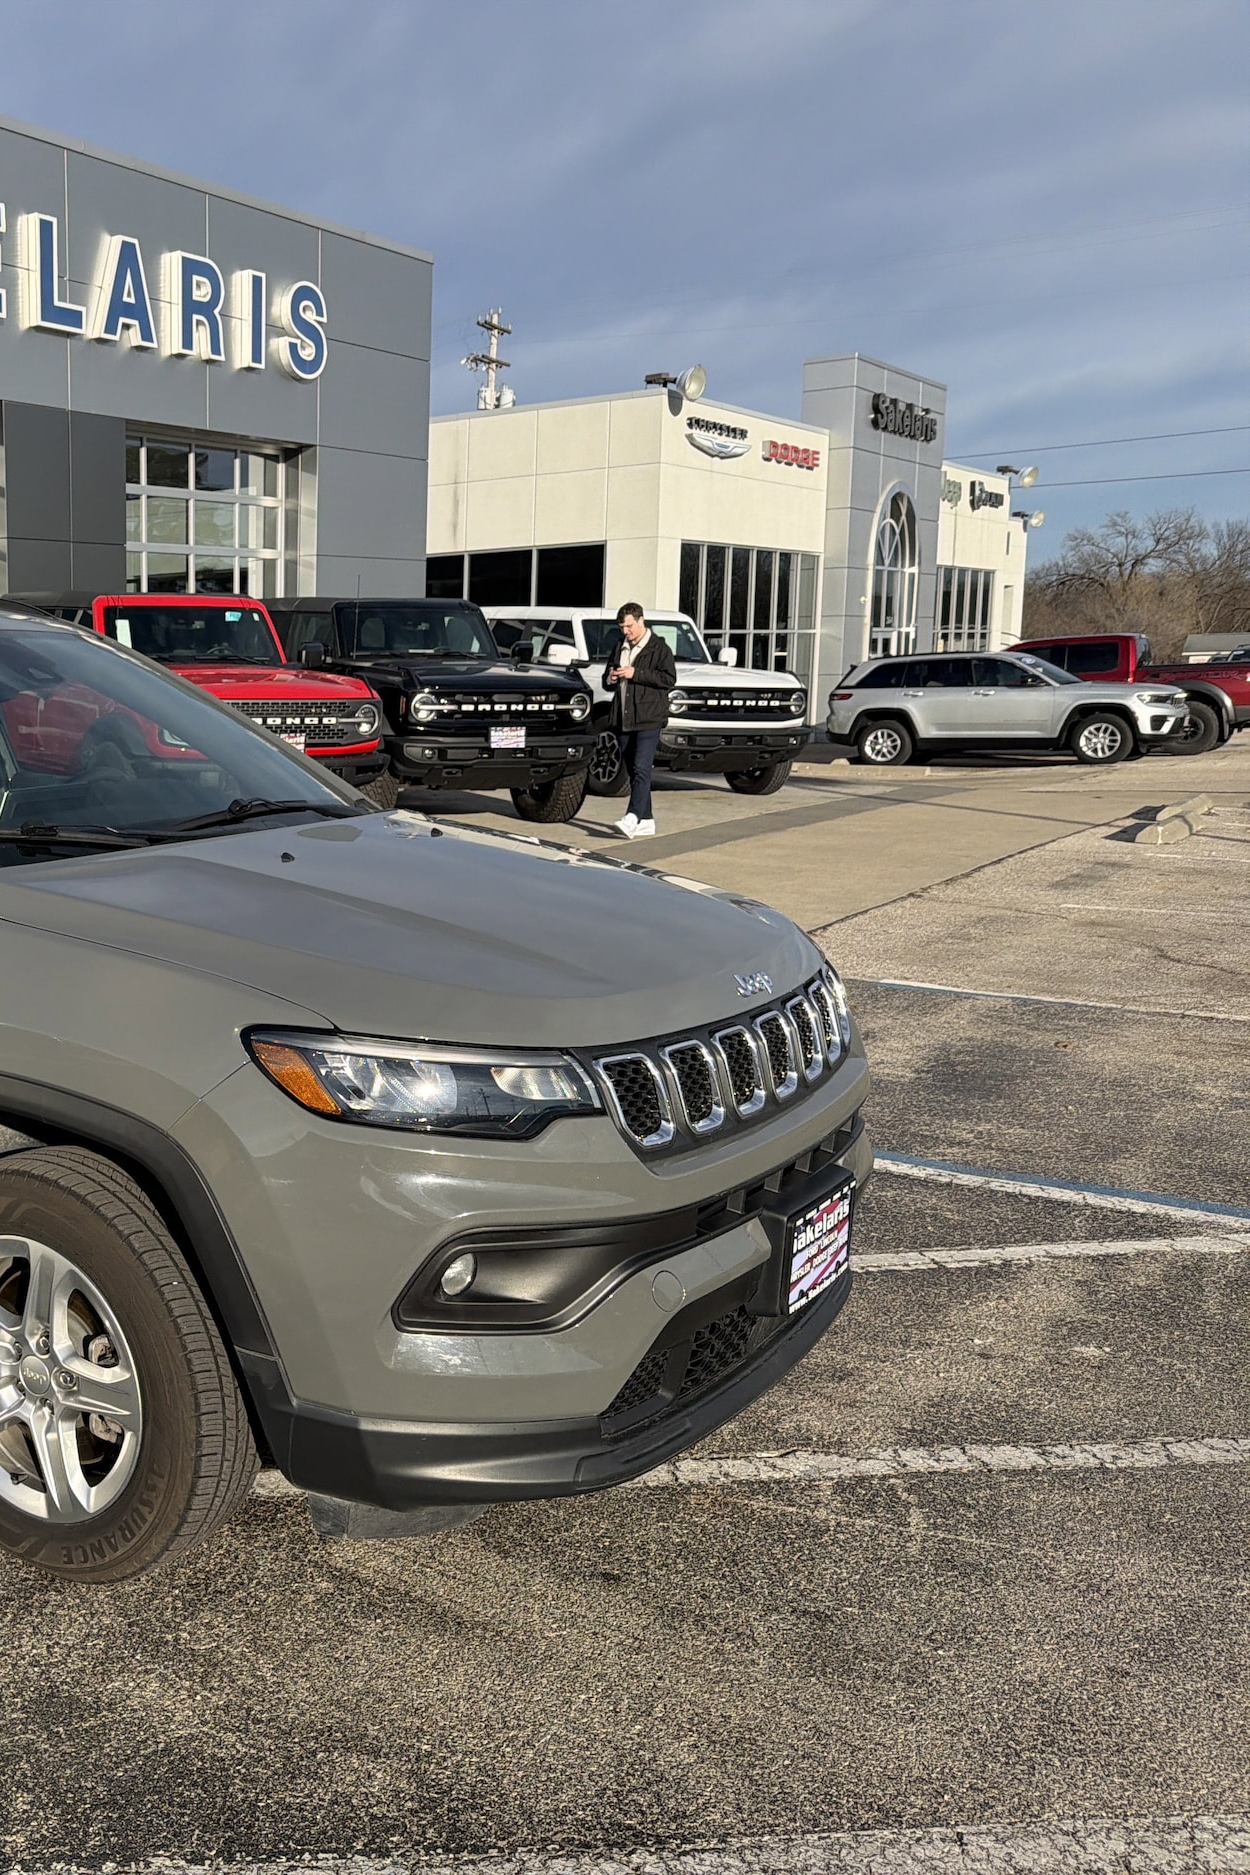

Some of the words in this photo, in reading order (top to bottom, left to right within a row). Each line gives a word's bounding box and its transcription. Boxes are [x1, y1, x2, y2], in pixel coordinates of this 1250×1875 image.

[686, 416, 748, 441] CHRYSLER
[869, 393, 937, 444] Sakelaris
[762, 440, 820, 471] DODGE
[460, 703, 555, 712] BRONCO
[707, 699, 780, 707] BRONCO
[251, 716, 337, 725] ONCO
[732, 970, 773, 998] Jeep
[790, 1261, 811, 1283] HRYSLER
